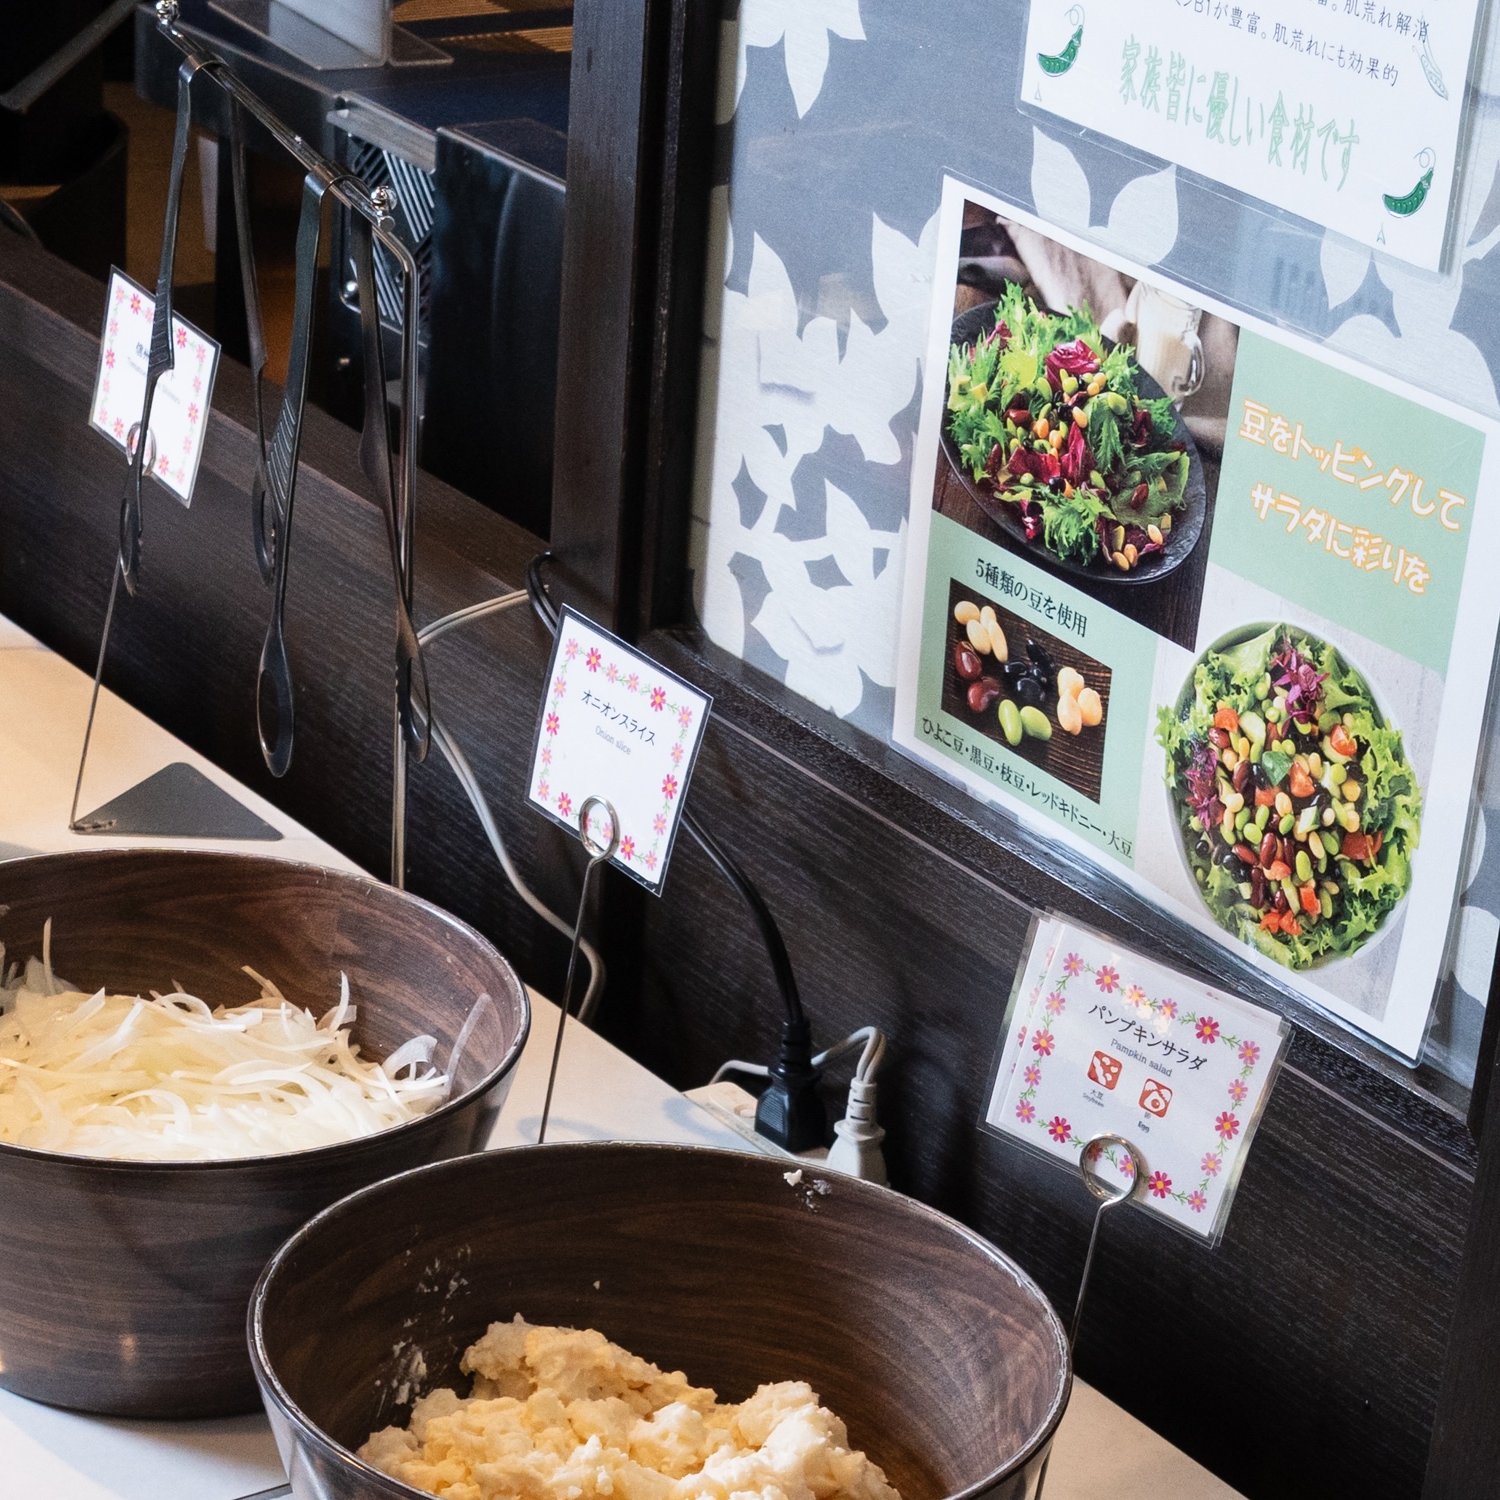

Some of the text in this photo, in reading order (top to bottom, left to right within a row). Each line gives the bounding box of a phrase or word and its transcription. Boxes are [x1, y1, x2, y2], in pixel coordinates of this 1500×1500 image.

[1118, 33, 1361, 192] 家族皆に優しい食材です
[1239, 397, 1468, 532] 豆をトッピングして
[1250, 481, 1432, 594] サラダに彩りを
[975, 558, 1088, 638] 5種類の豆を使用
[580, 689, 656, 746] オニオンスライス
[596, 726, 631, 755] Onion slice
[921, 716, 1133, 860] ひよこ豆・黒豆・枝豆・レッドキドニー・大豆
[1088, 1003, 1208, 1072] パンプキンサラダ
[1149, 1058, 1173, 1077] salad
[1137, 1120, 1150, 1134] Egg
